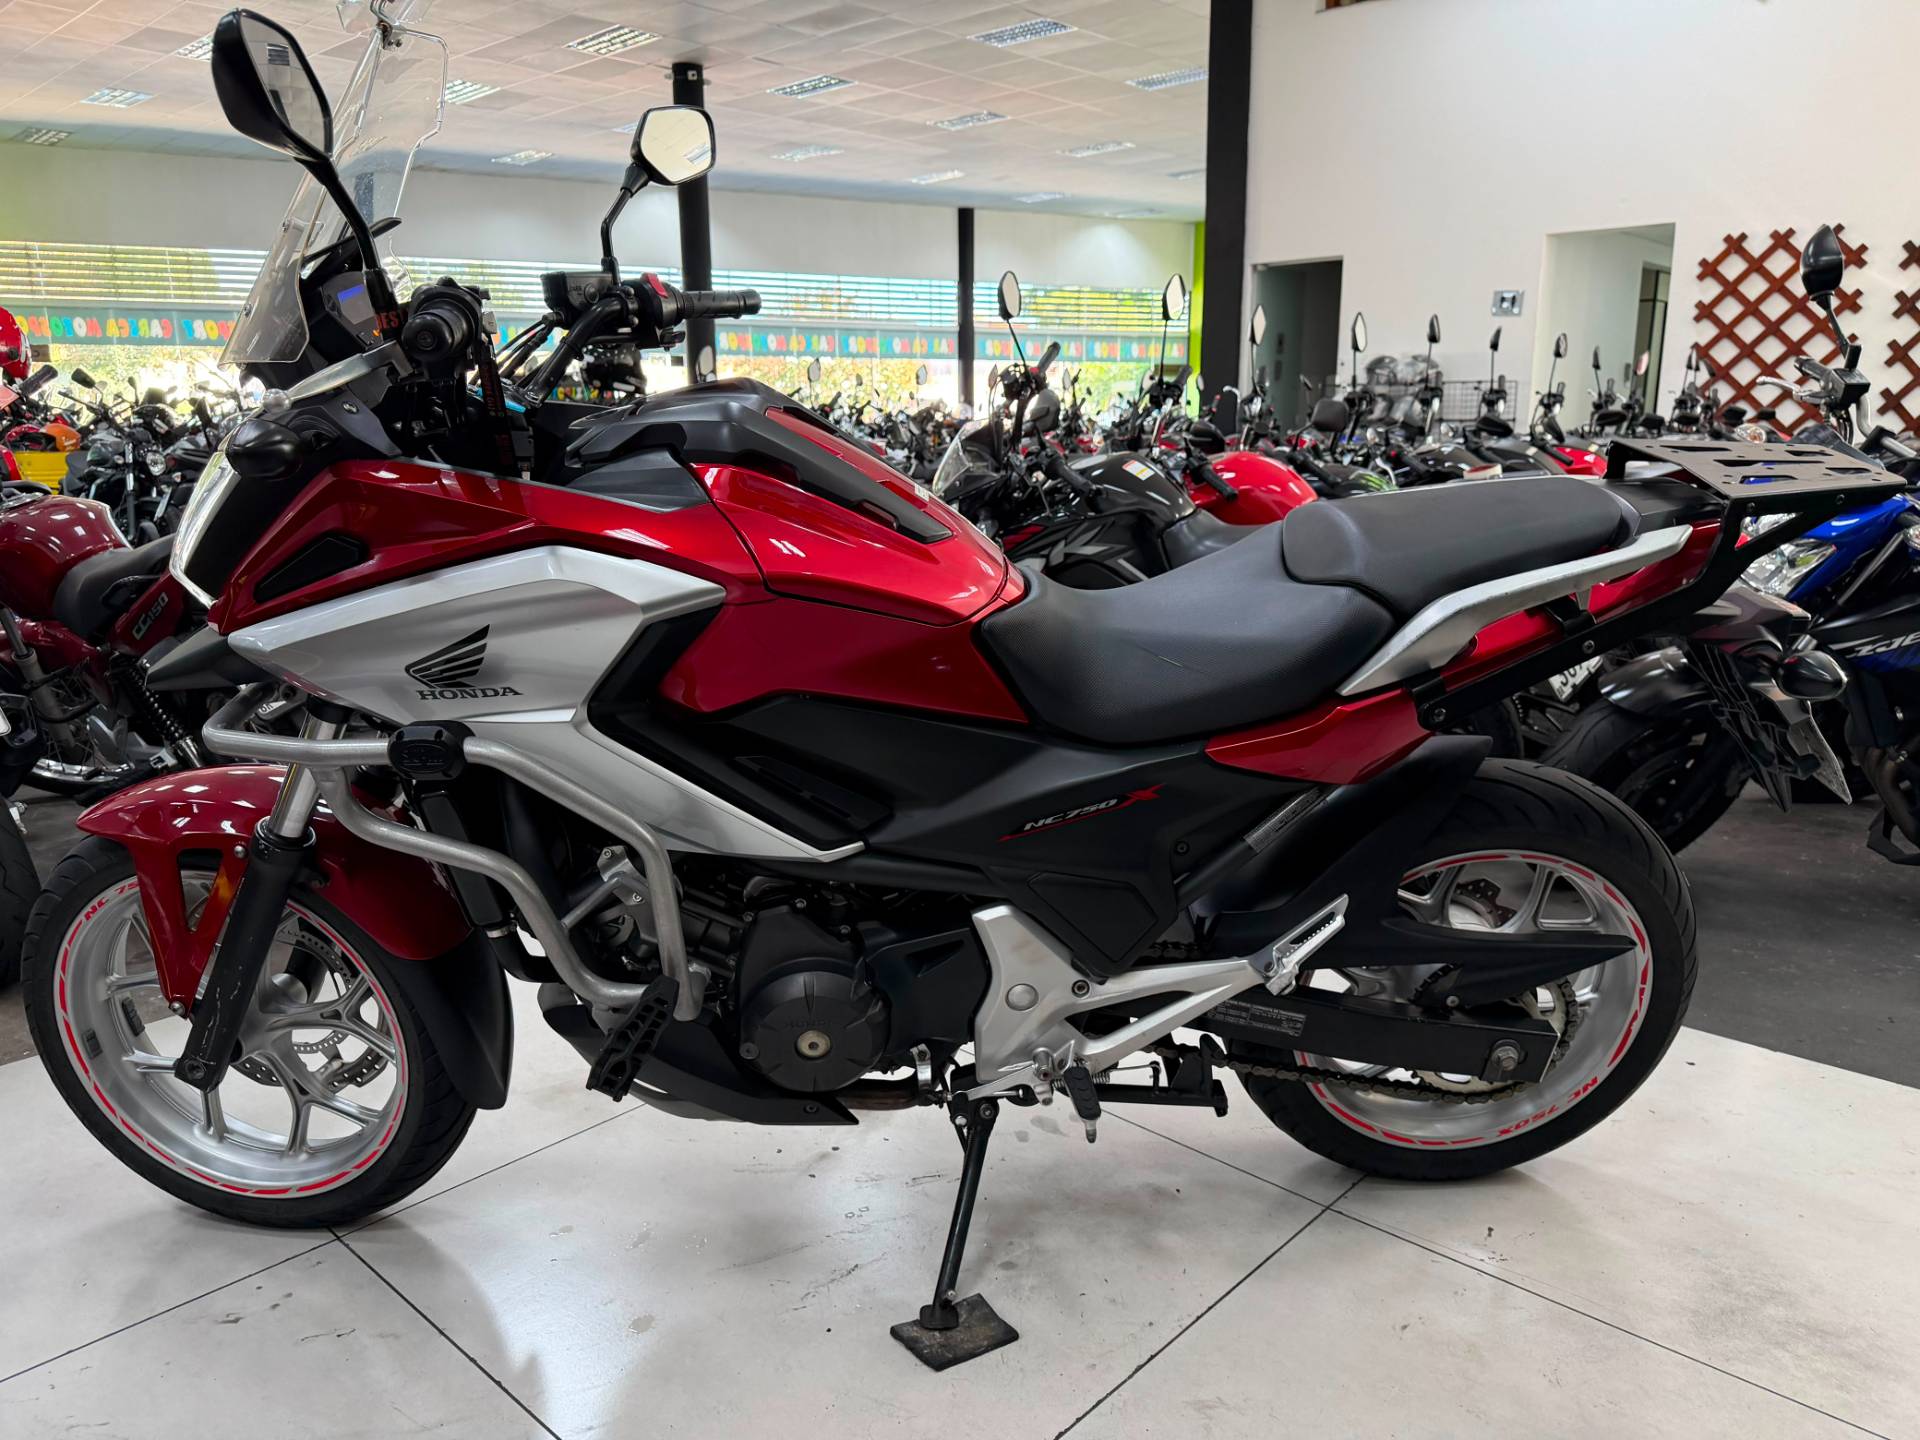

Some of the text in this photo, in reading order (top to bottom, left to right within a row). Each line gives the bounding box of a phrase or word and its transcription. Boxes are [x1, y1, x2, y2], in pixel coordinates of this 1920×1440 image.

[416, 686, 524, 700] HONDA
[1023, 784, 1165, 831] NC750X
[84, 881, 139, 921] NC 75
[1496, 1076, 1600, 1138] NC 750X
